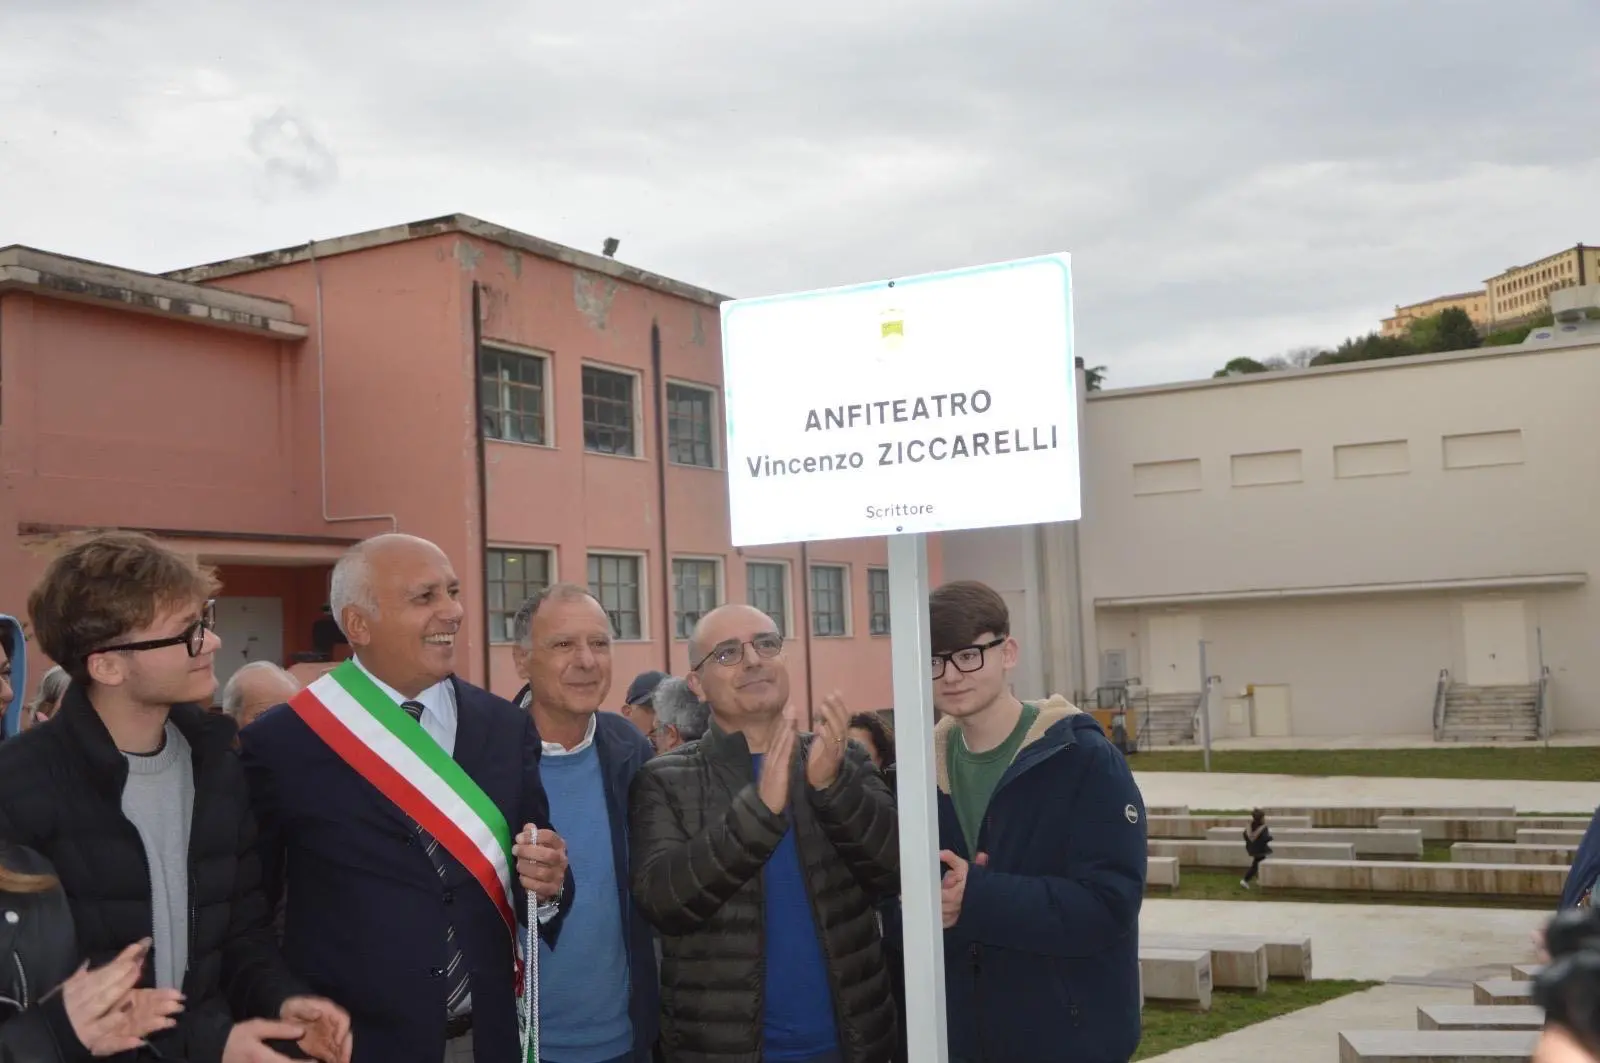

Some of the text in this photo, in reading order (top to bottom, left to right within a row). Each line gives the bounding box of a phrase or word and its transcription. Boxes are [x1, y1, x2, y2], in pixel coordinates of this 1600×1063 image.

[805, 389, 992, 432] ANFITEATRO
[746, 425, 1057, 478] Vincenzo ZICCARELLI
[866, 503, 934, 519] Scrittore
